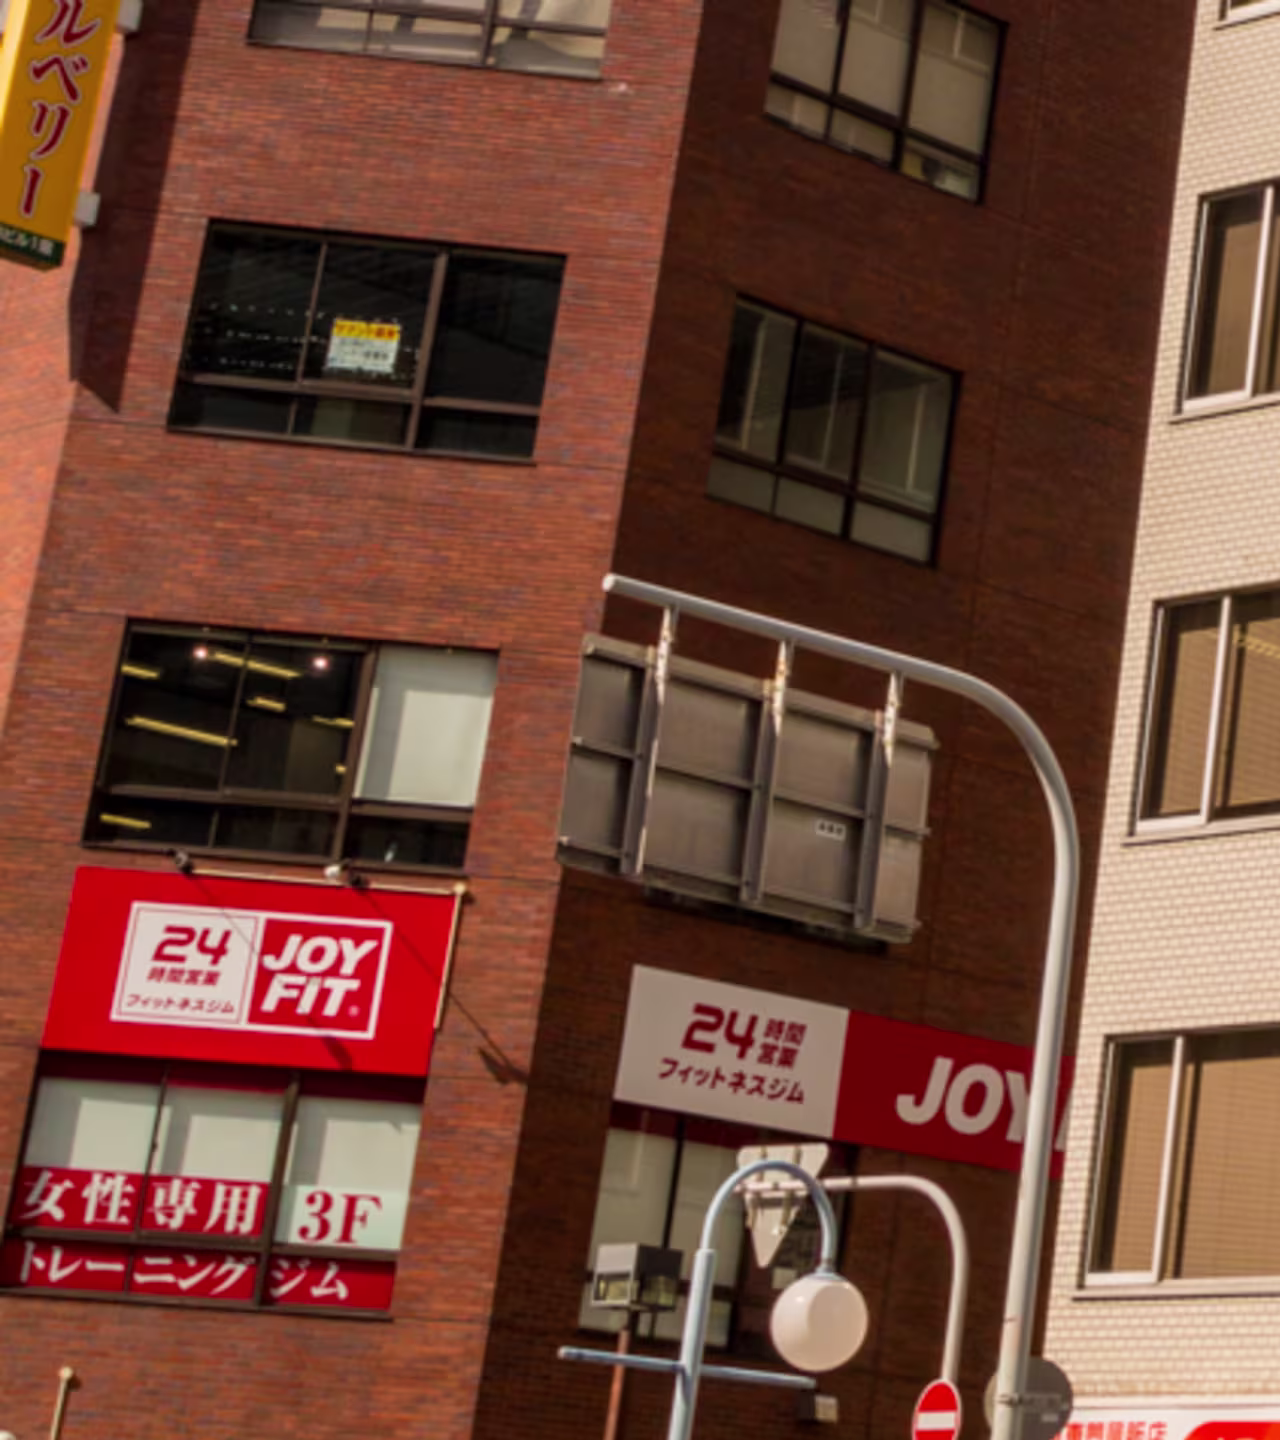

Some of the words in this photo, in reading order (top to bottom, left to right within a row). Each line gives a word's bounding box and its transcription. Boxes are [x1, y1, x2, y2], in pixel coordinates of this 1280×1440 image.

[151, 925, 232, 967] 24
[263, 934, 377, 975] JOY
[147, 967, 220, 987] 時間営業
[260, 975, 361, 1018] FIT
[126, 994, 235, 1015] フィットネスジム
[681, 1003, 759, 1059] 24
[763, 1017, 807, 1046] 時間
[757, 1041, 799, 1069] 営業
[658, 1057, 805, 1105] フィットネスジム
[18, 1170, 263, 1236] 女性専用
[297, 1190, 383, 1245] 3F
[18, 1240, 350, 1300] トレーニングジム
